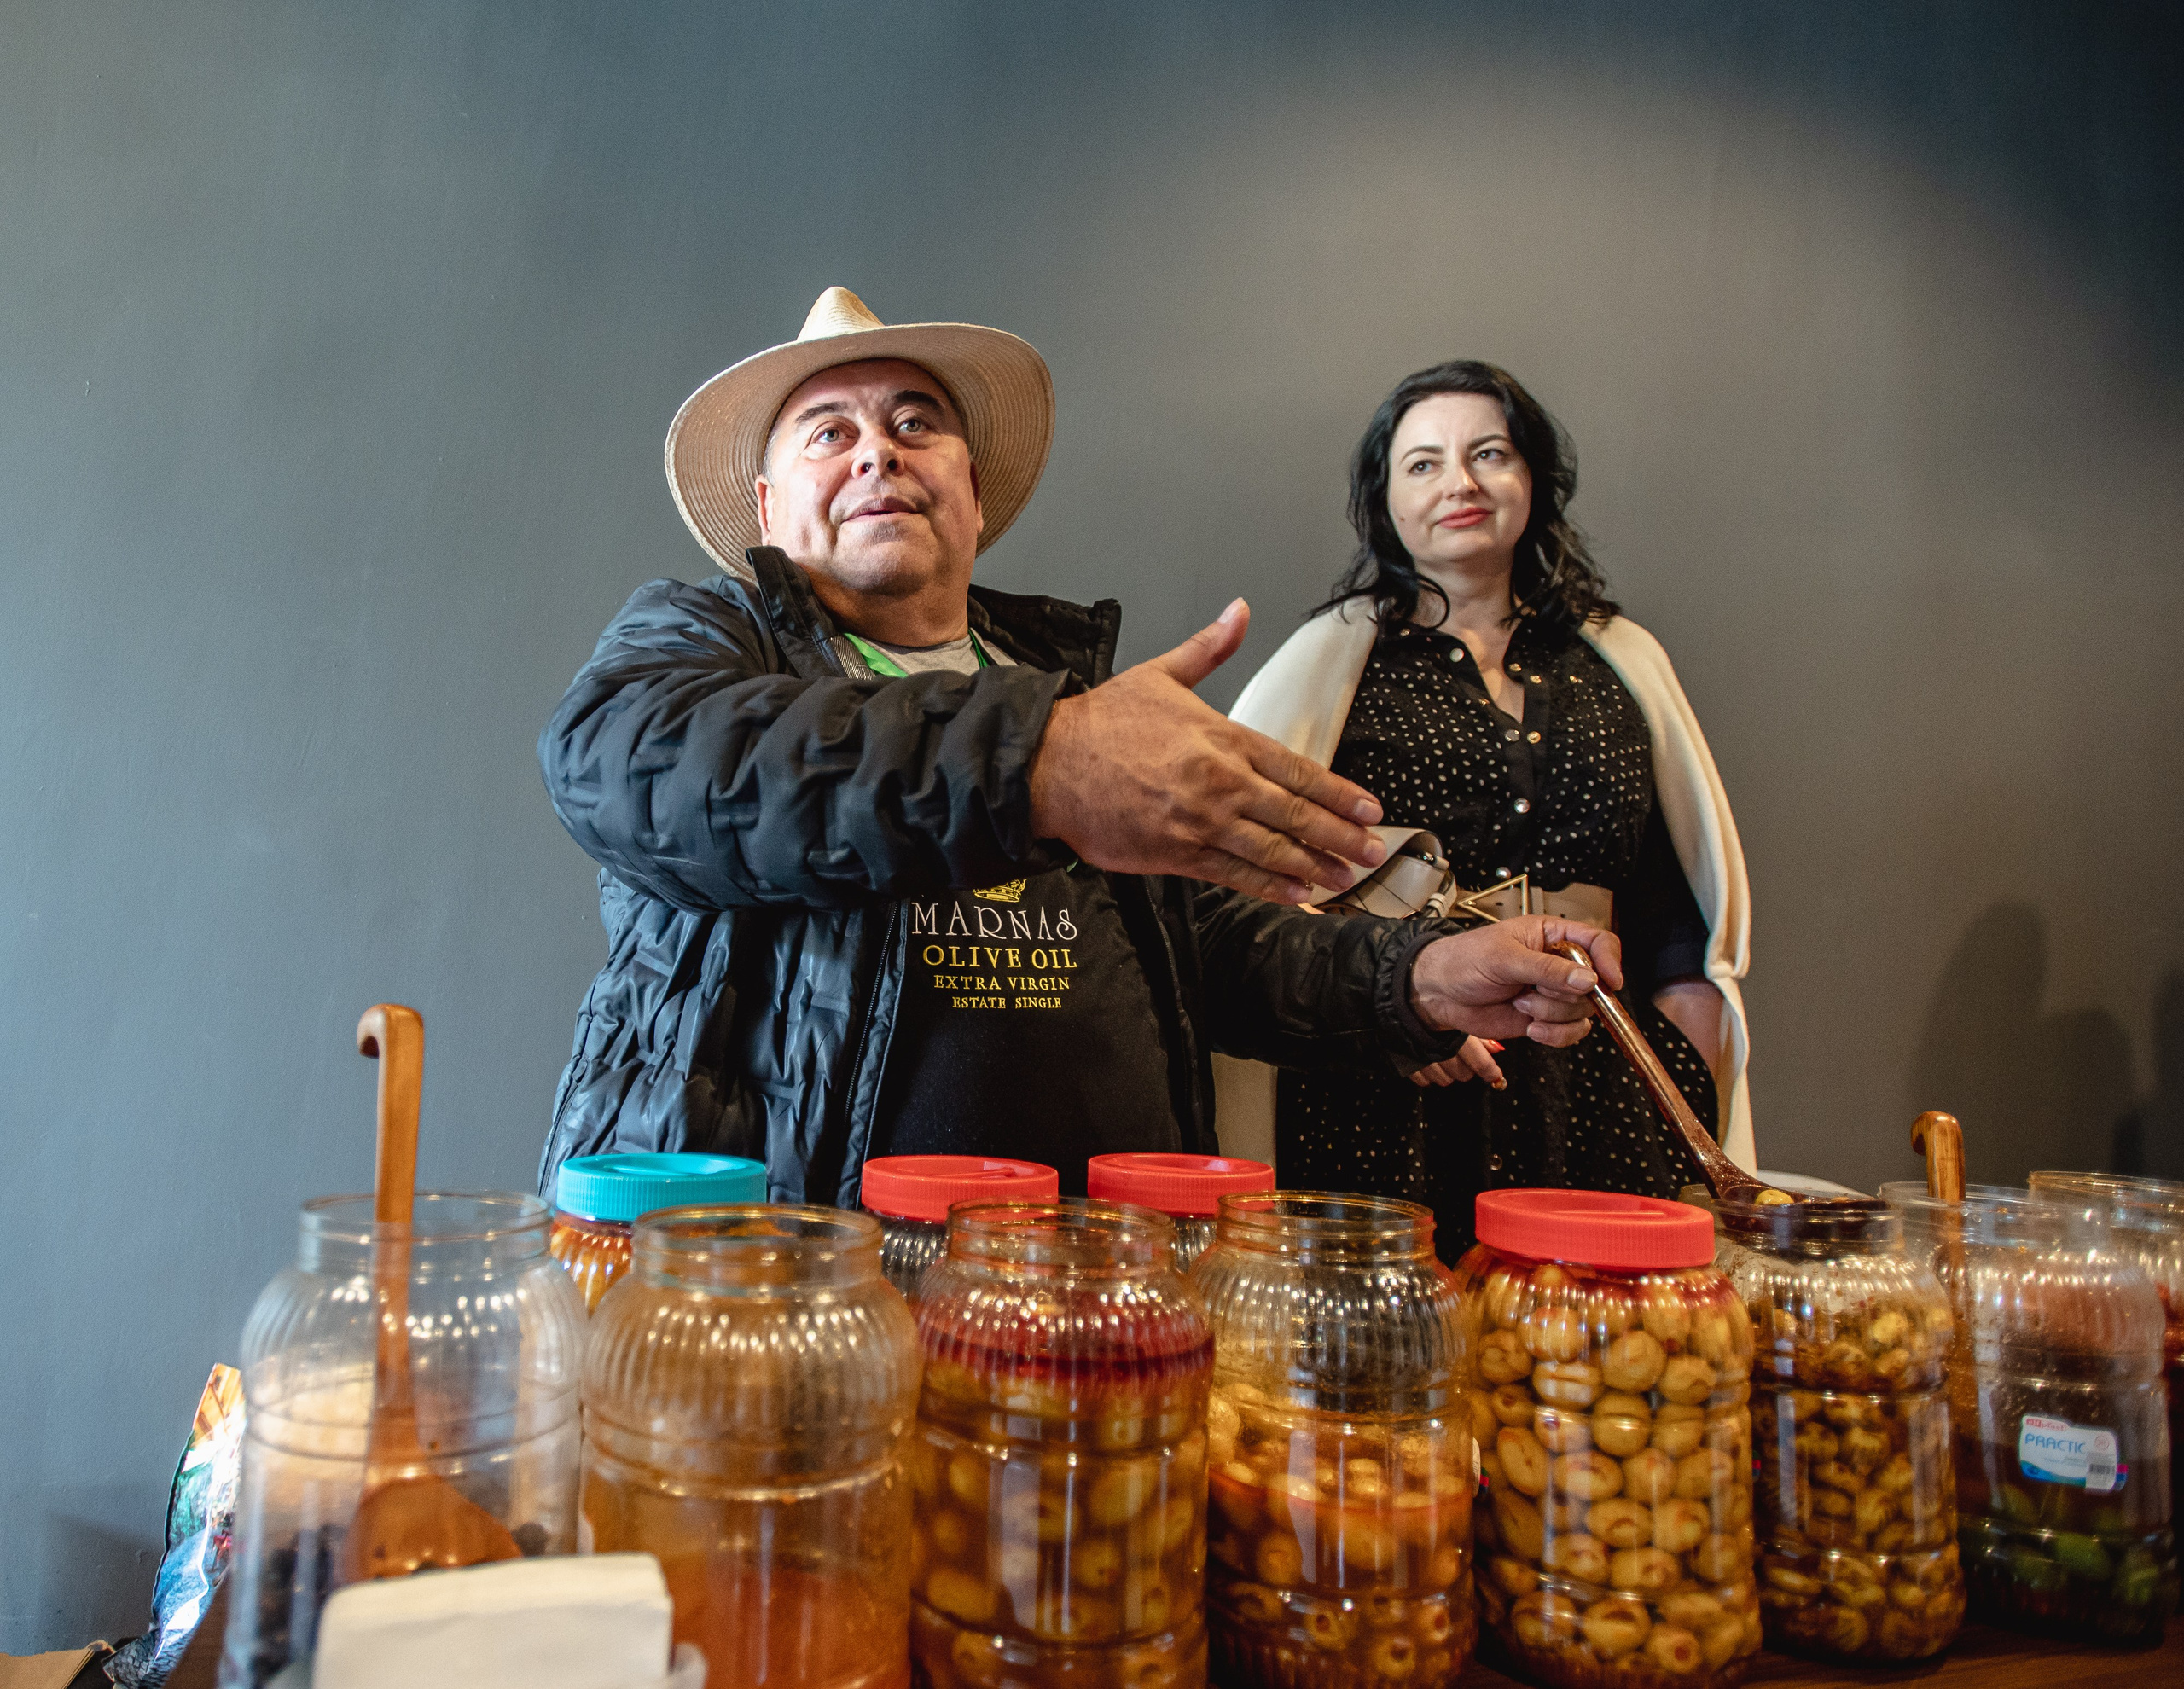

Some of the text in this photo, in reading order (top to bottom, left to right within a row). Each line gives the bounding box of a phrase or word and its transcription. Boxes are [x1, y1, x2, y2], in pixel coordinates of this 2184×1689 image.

[911, 900, 1078, 941] MARNAS
[922, 944, 1077, 969] OLIVE OIL
[933, 974, 1070, 990] EXTRA VIRGIN
[952, 996, 1062, 1009] ESTATE SINGLE
[2025, 1433, 2085, 1454] PRACTIC
